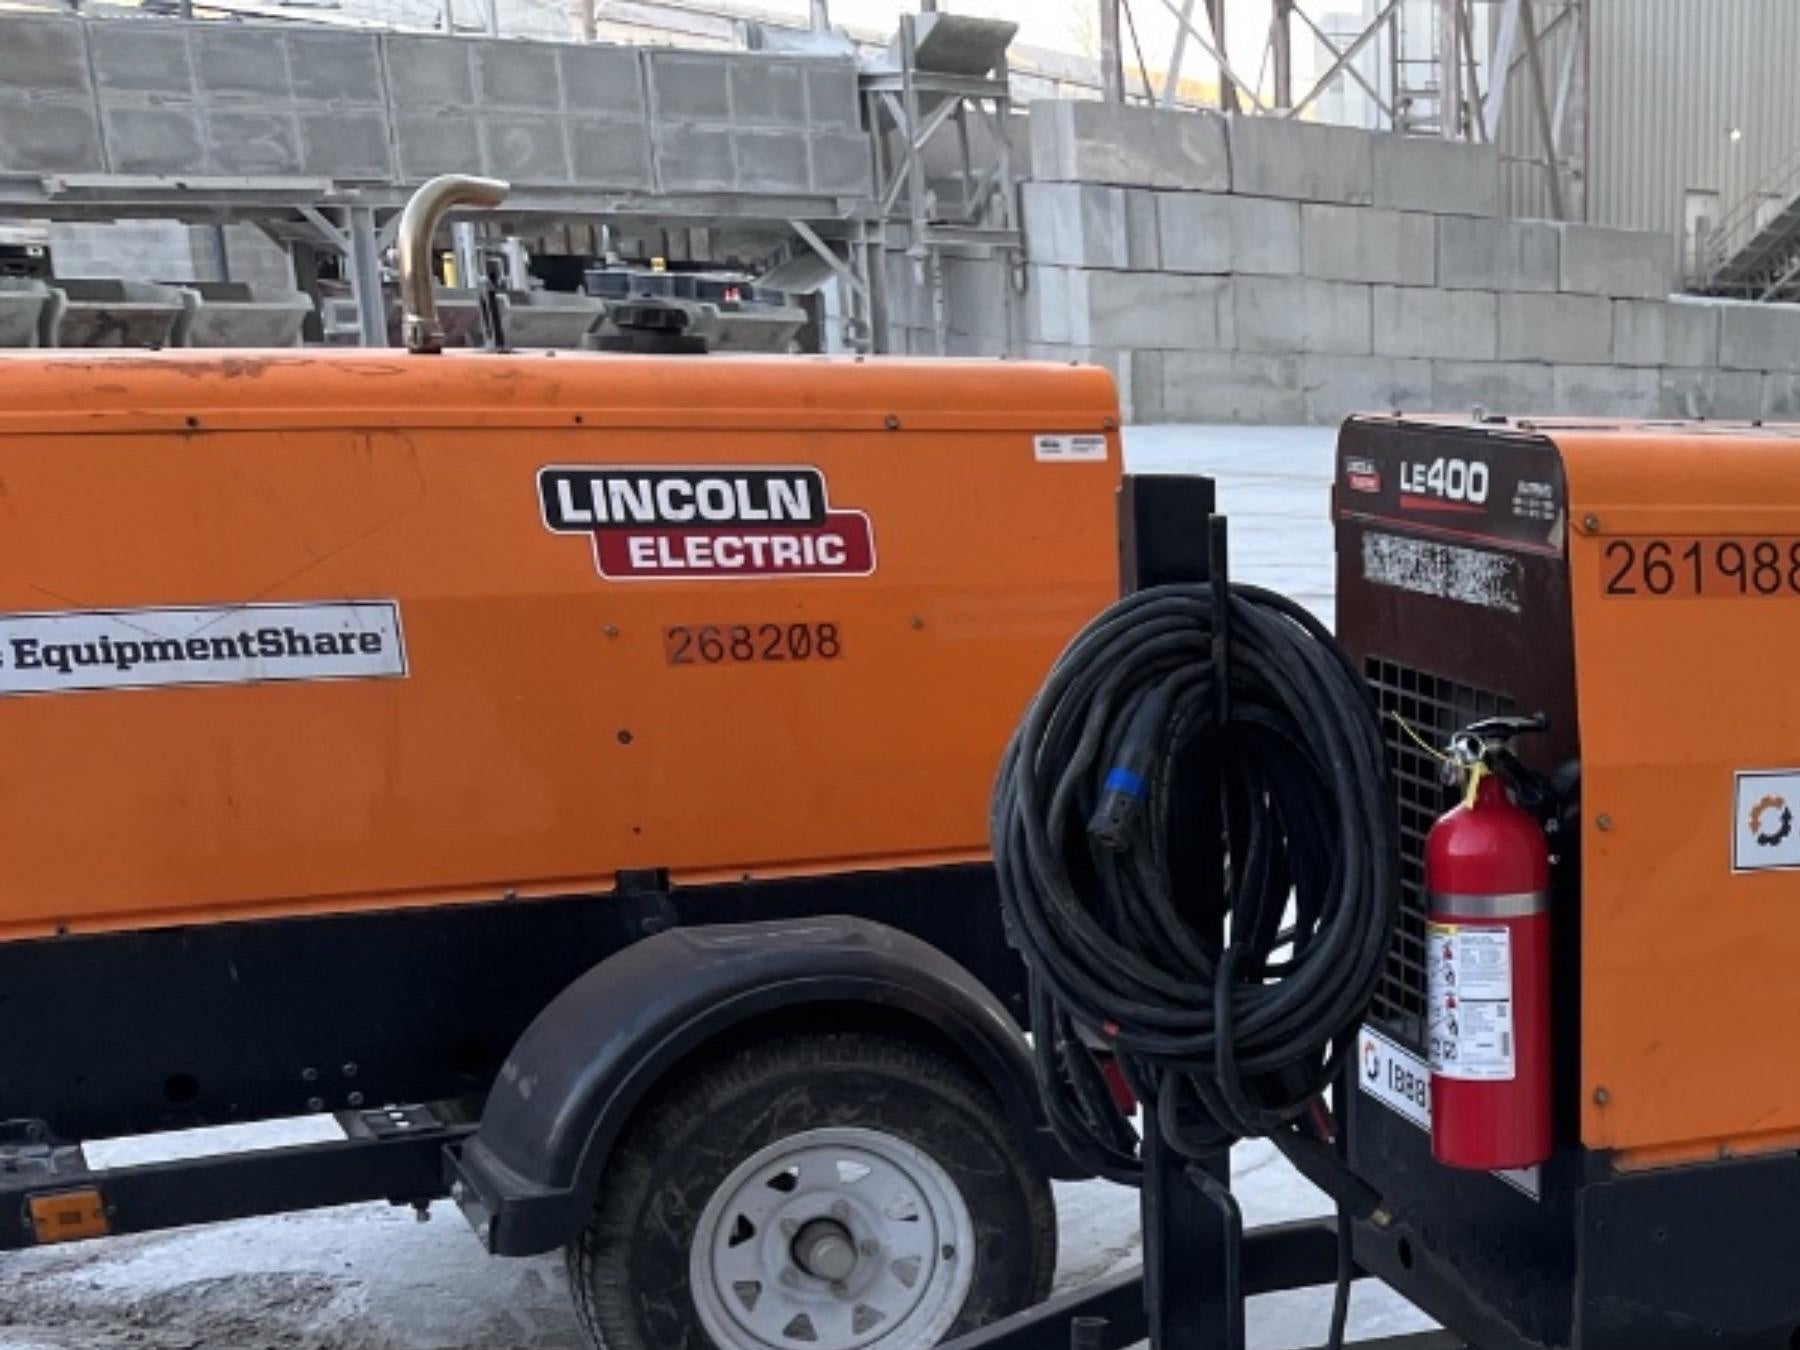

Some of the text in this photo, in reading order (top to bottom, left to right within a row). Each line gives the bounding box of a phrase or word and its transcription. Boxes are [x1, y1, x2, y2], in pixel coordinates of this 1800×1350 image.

[556, 478, 813, 523] LINCOLN
[1400, 457, 1490, 504] LE400
[628, 535, 847, 569] ELECTRIC
[9, 627, 384, 674] EquipmentShare
[666, 621, 843, 666] 268208
